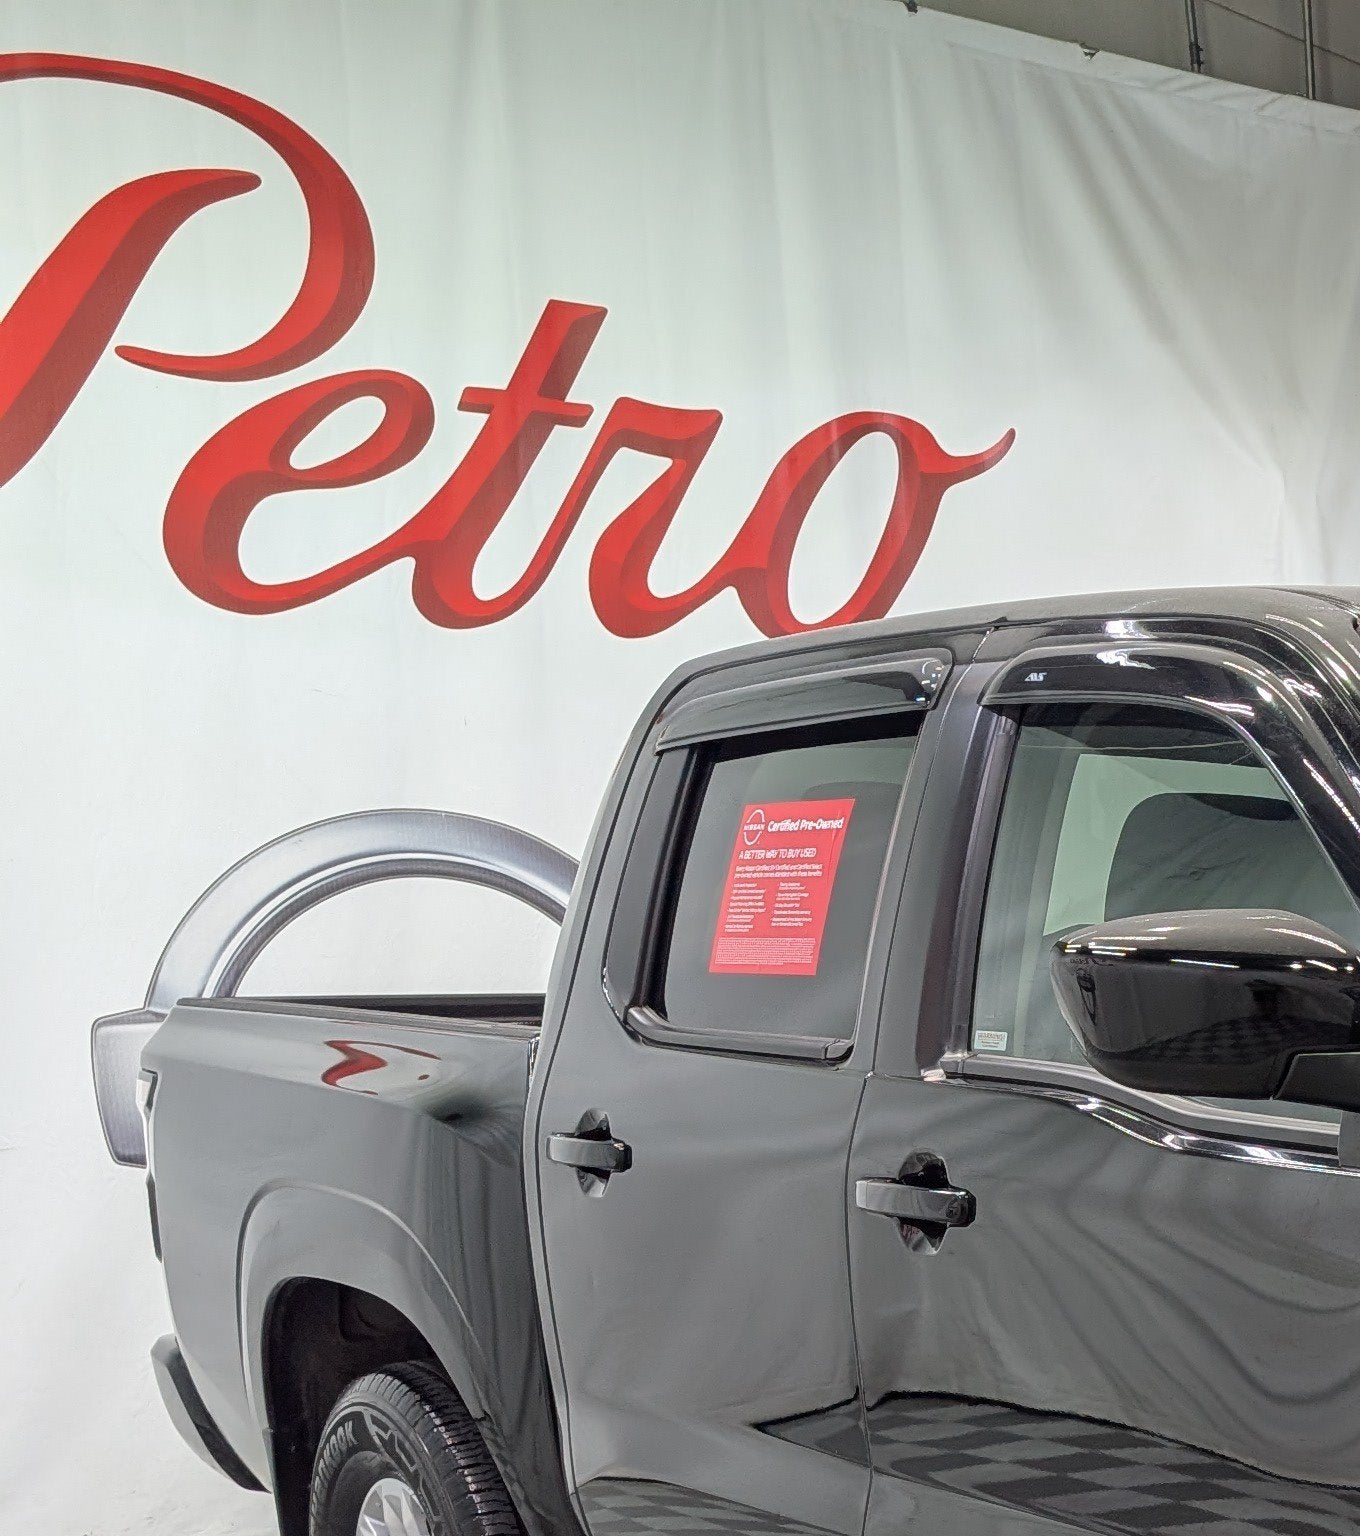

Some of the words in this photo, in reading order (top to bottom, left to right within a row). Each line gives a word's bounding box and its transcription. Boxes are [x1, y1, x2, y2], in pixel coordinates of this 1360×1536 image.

[0, 52, 1015, 639] Petro
[767, 818, 799, 832] Certified
[799, 816, 845, 831] Pre-Owned
